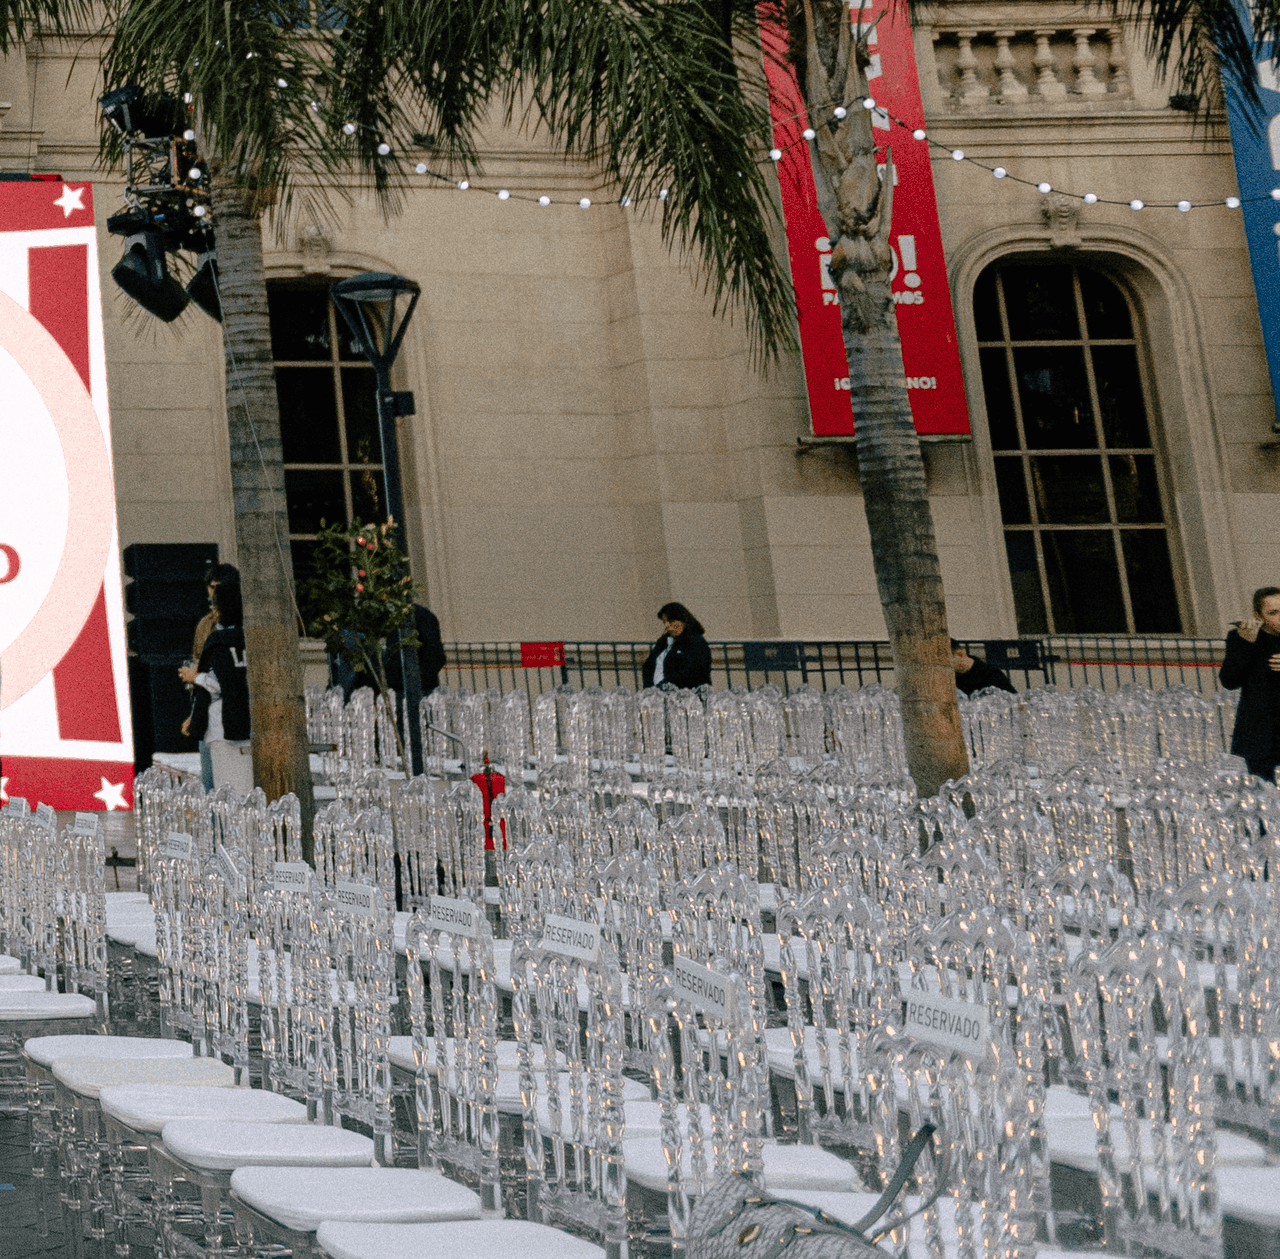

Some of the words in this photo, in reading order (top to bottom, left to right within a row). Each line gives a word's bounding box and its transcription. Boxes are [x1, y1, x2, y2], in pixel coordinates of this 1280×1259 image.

[275, 870, 306, 884] RESERVADO
[338, 890, 371, 908] RESERVADO
[432, 905, 472, 927] RESERVADO
[545, 924, 594, 950] RESERVADO
[675, 968, 726, 1007] RESERVADO
[909, 1003, 980, 1041] RESERVADO
